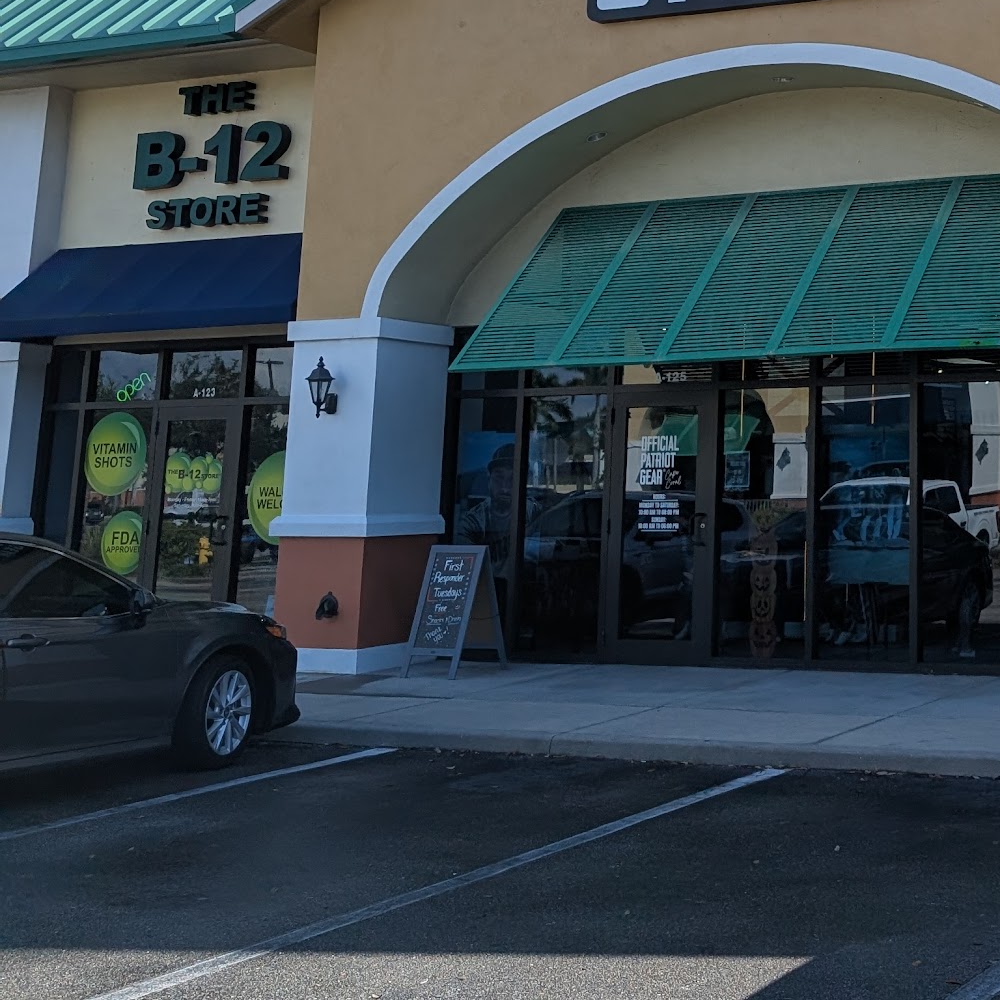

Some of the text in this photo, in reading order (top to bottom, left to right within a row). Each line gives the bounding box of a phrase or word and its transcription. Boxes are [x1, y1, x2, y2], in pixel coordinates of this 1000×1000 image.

[179, 81, 256, 116] THE
[133, 121, 292, 190] B-12
[146, 193, 270, 230] STORE
[117, 373, 151, 401] open
[193, 387, 216, 398] A-123
[93, 442, 137, 455] VITAMIN
[641, 435, 679, 451] OFFICIAL
[94, 456, 132, 468] SHOTS
[640, 452, 677, 468] PATRIOT
[178, 469, 201, 479] B-12
[640, 469, 663, 485] GEAR
[259, 486, 282, 497] WAL
[112, 531, 139, 545] FDA
[444, 560, 464, 571] First
[433, 572, 465, 584] Responder
[434, 587, 462, 600] Tuesdays
[435, 604, 447, 612] Free
